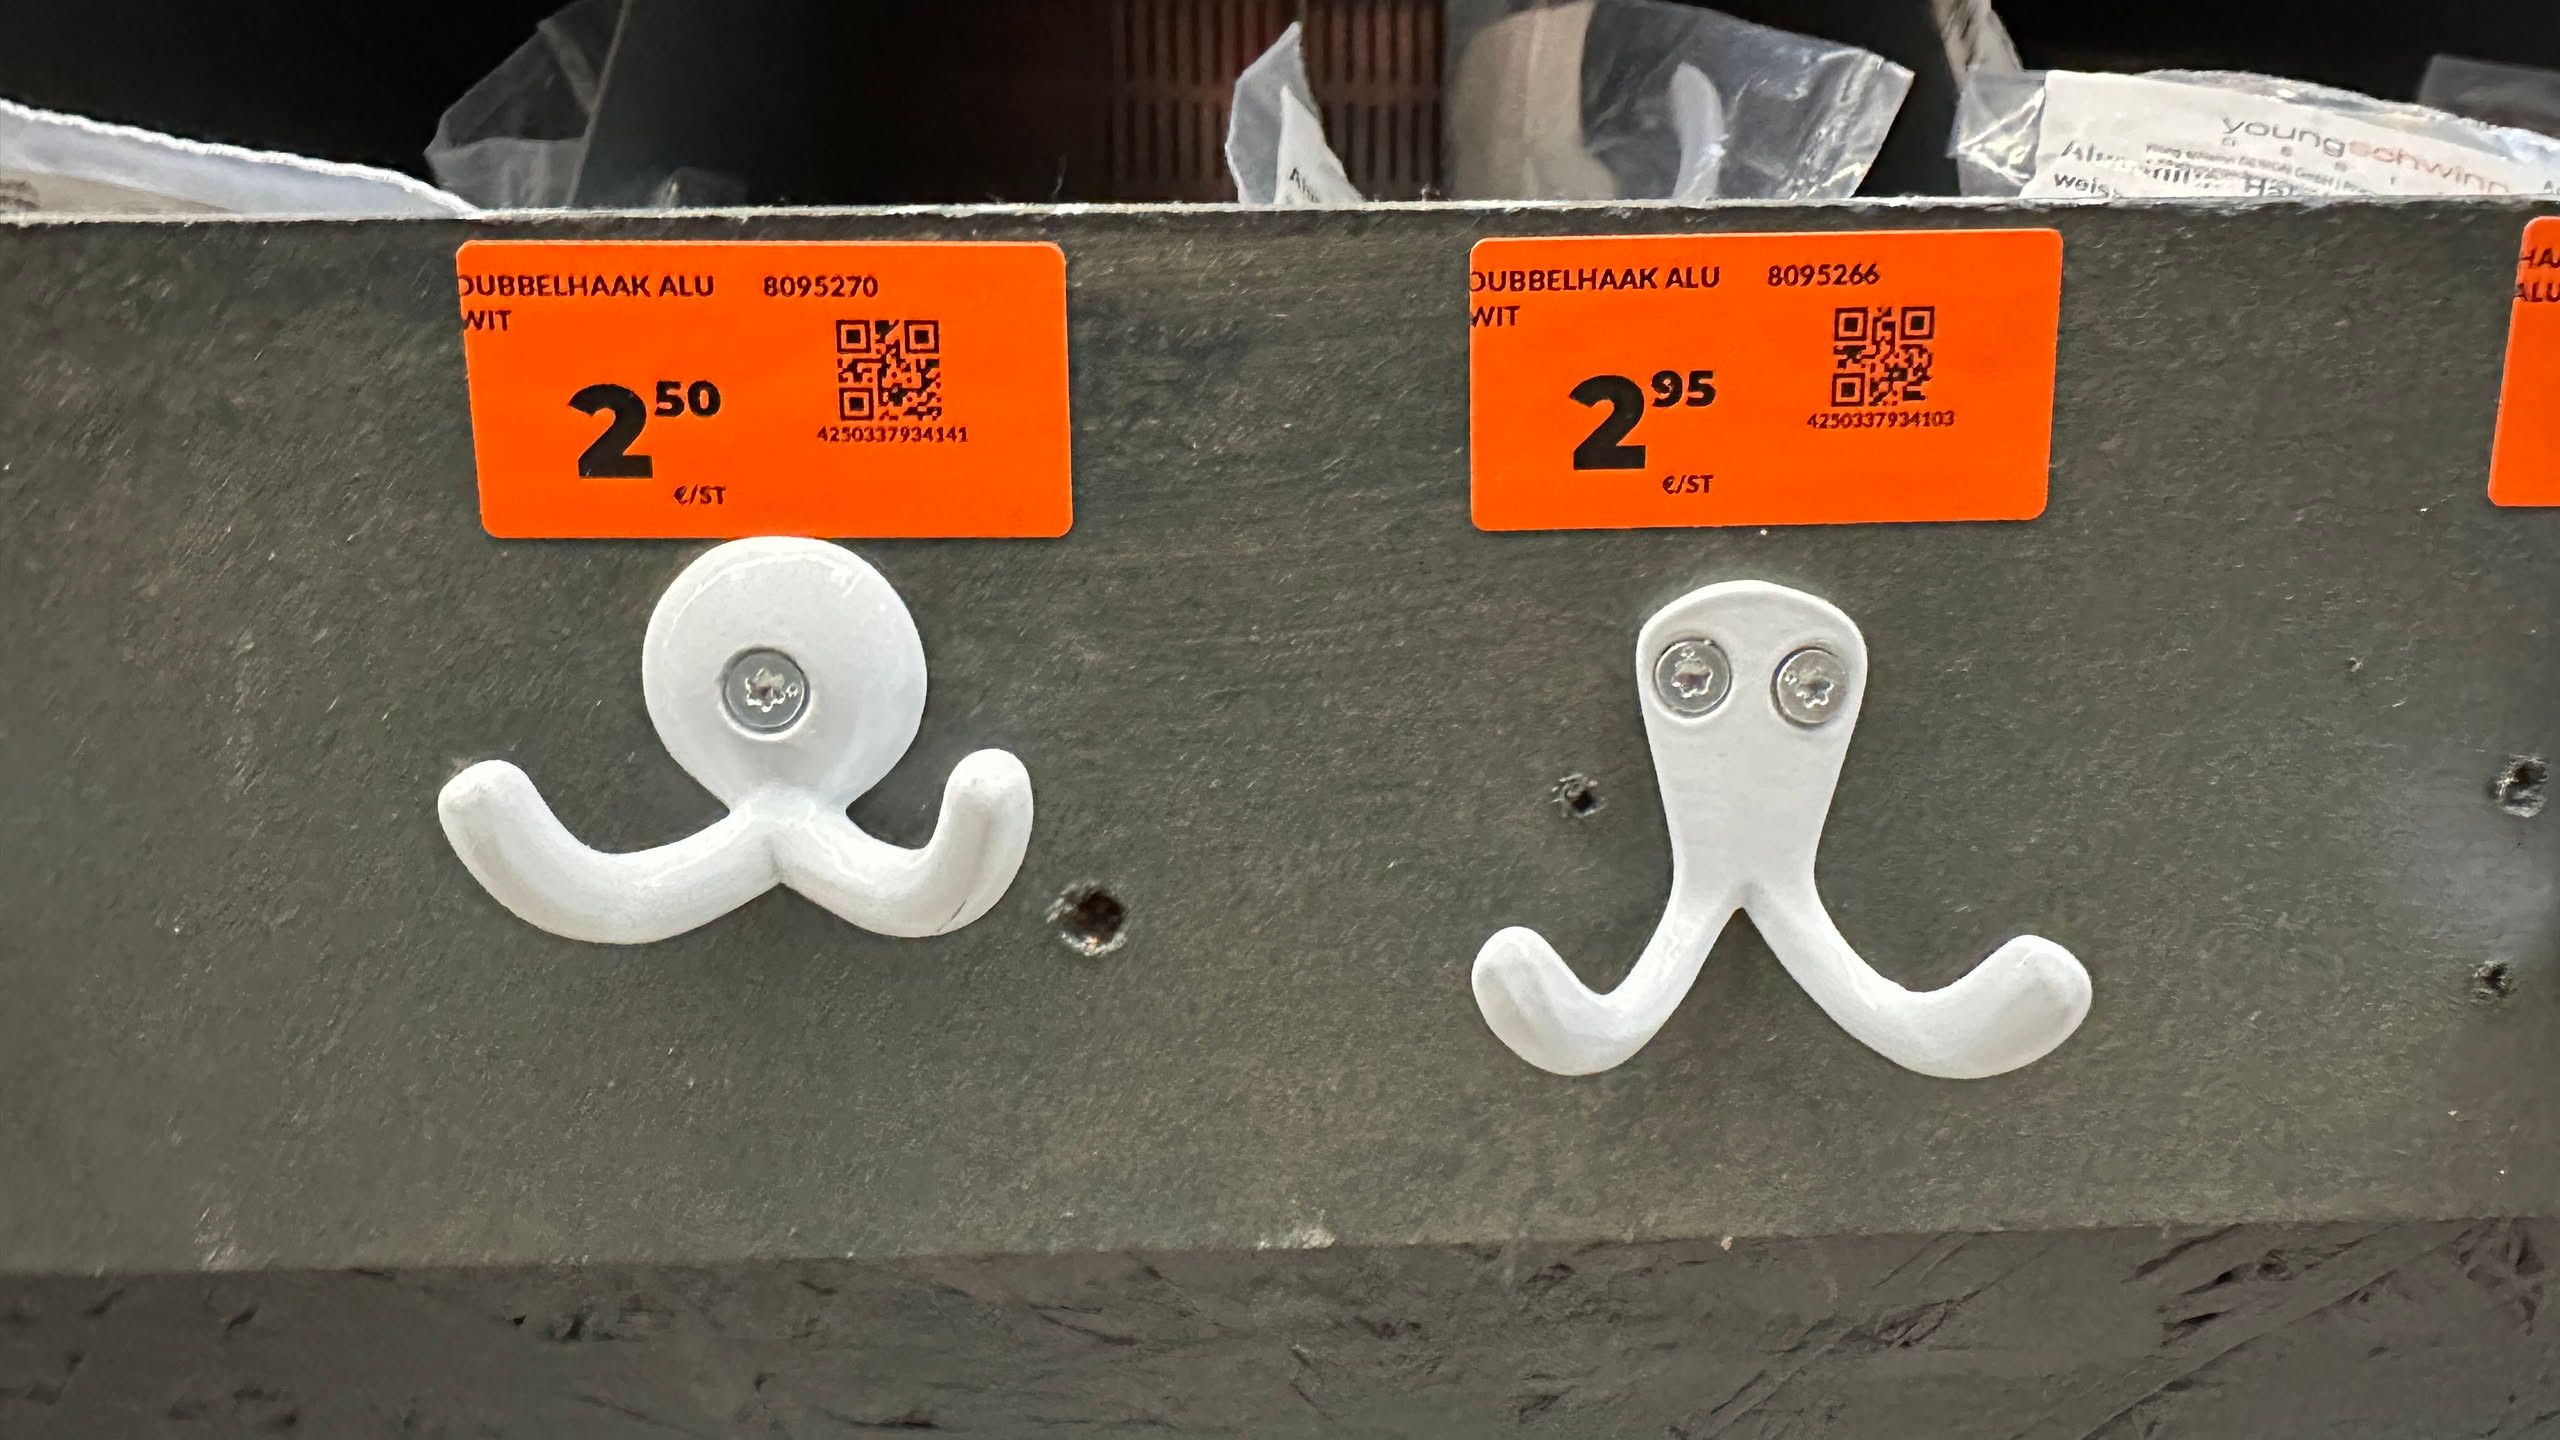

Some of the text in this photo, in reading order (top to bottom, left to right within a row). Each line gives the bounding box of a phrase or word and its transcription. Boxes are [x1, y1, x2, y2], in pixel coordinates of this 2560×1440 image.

[659, 275, 714, 296] ALU
[763, 275, 879, 298] 8095270
[1665, 266, 1720, 289] ALU
[1768, 263, 1881, 287] 8095266
[462, 310, 512, 331] WIT
[1471, 305, 1520, 327] WIT
[568, 380, 721, 479] 2 50
[1569, 369, 1717, 471] 2 95
[1806, 410, 1955, 429] 4250337934103
[816, 426, 968, 443] 4250337934141
[1662, 474, 1714, 495] €/ST
[673, 486, 726, 505] €/ST
